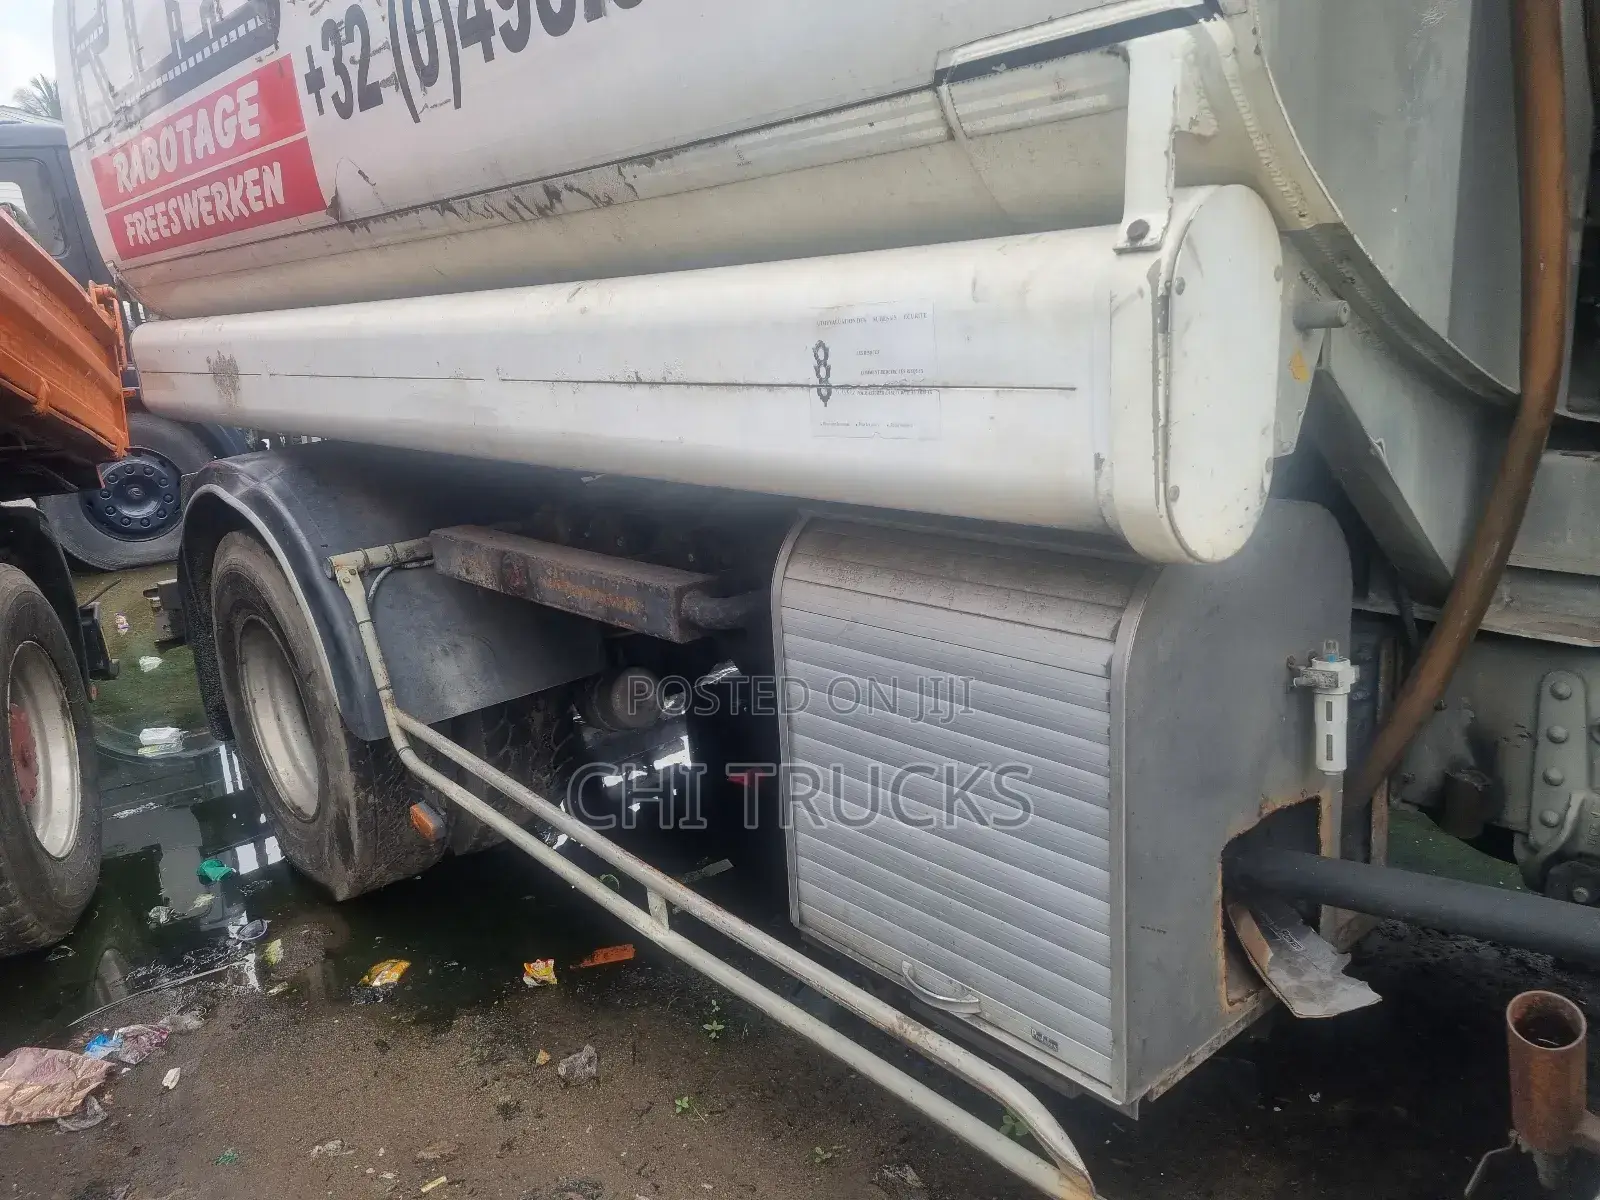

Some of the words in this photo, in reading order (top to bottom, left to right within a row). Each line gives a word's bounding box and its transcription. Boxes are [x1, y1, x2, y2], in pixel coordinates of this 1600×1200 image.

[304, 4, 384, 121] +32
[112, 79, 261, 194] RABOTAGE
[123, 161, 285, 247] FREESWERKEN
